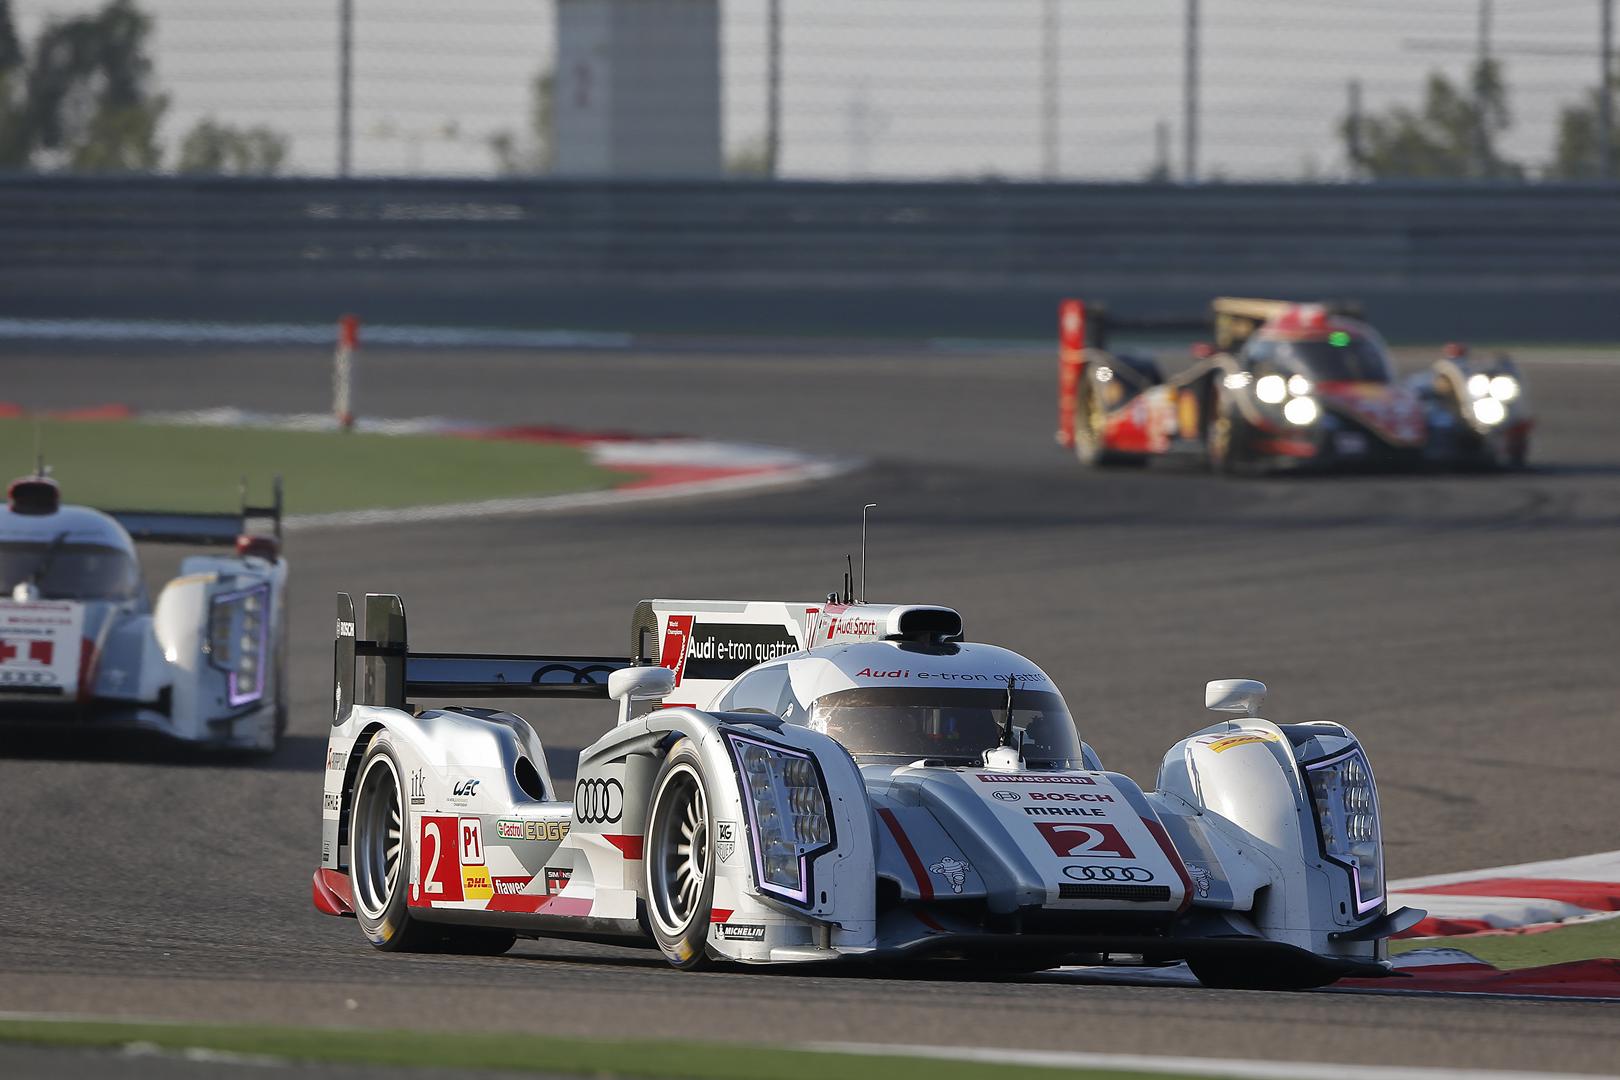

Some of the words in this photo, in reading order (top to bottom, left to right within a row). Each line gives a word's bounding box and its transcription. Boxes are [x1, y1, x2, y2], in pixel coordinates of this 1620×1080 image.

[836, 618, 853, 635] Audi
[854, 617, 876, 638] Sport
[687, 636, 715, 659] Audi
[717, 640, 752, 660] e-tron
[855, 667, 911, 678] Audi
[917, 672, 987, 681] e-tron
[410, 767, 427, 797] itk
[453, 779, 480, 796] WEC
[1028, 792, 1115, 803] BOSCH
[1023, 807, 1107, 817] MAHLE
[504, 822, 523, 837] Castrol
[526, 821, 571, 840] EDGE
[719, 824, 732, 839] TAG
[463, 826, 480, 858] P1
[1052, 825, 1121, 857] 2
[424, 822, 444, 894] 2
[466, 877, 488, 888] DHL
[724, 926, 765, 937] MICHELIN
